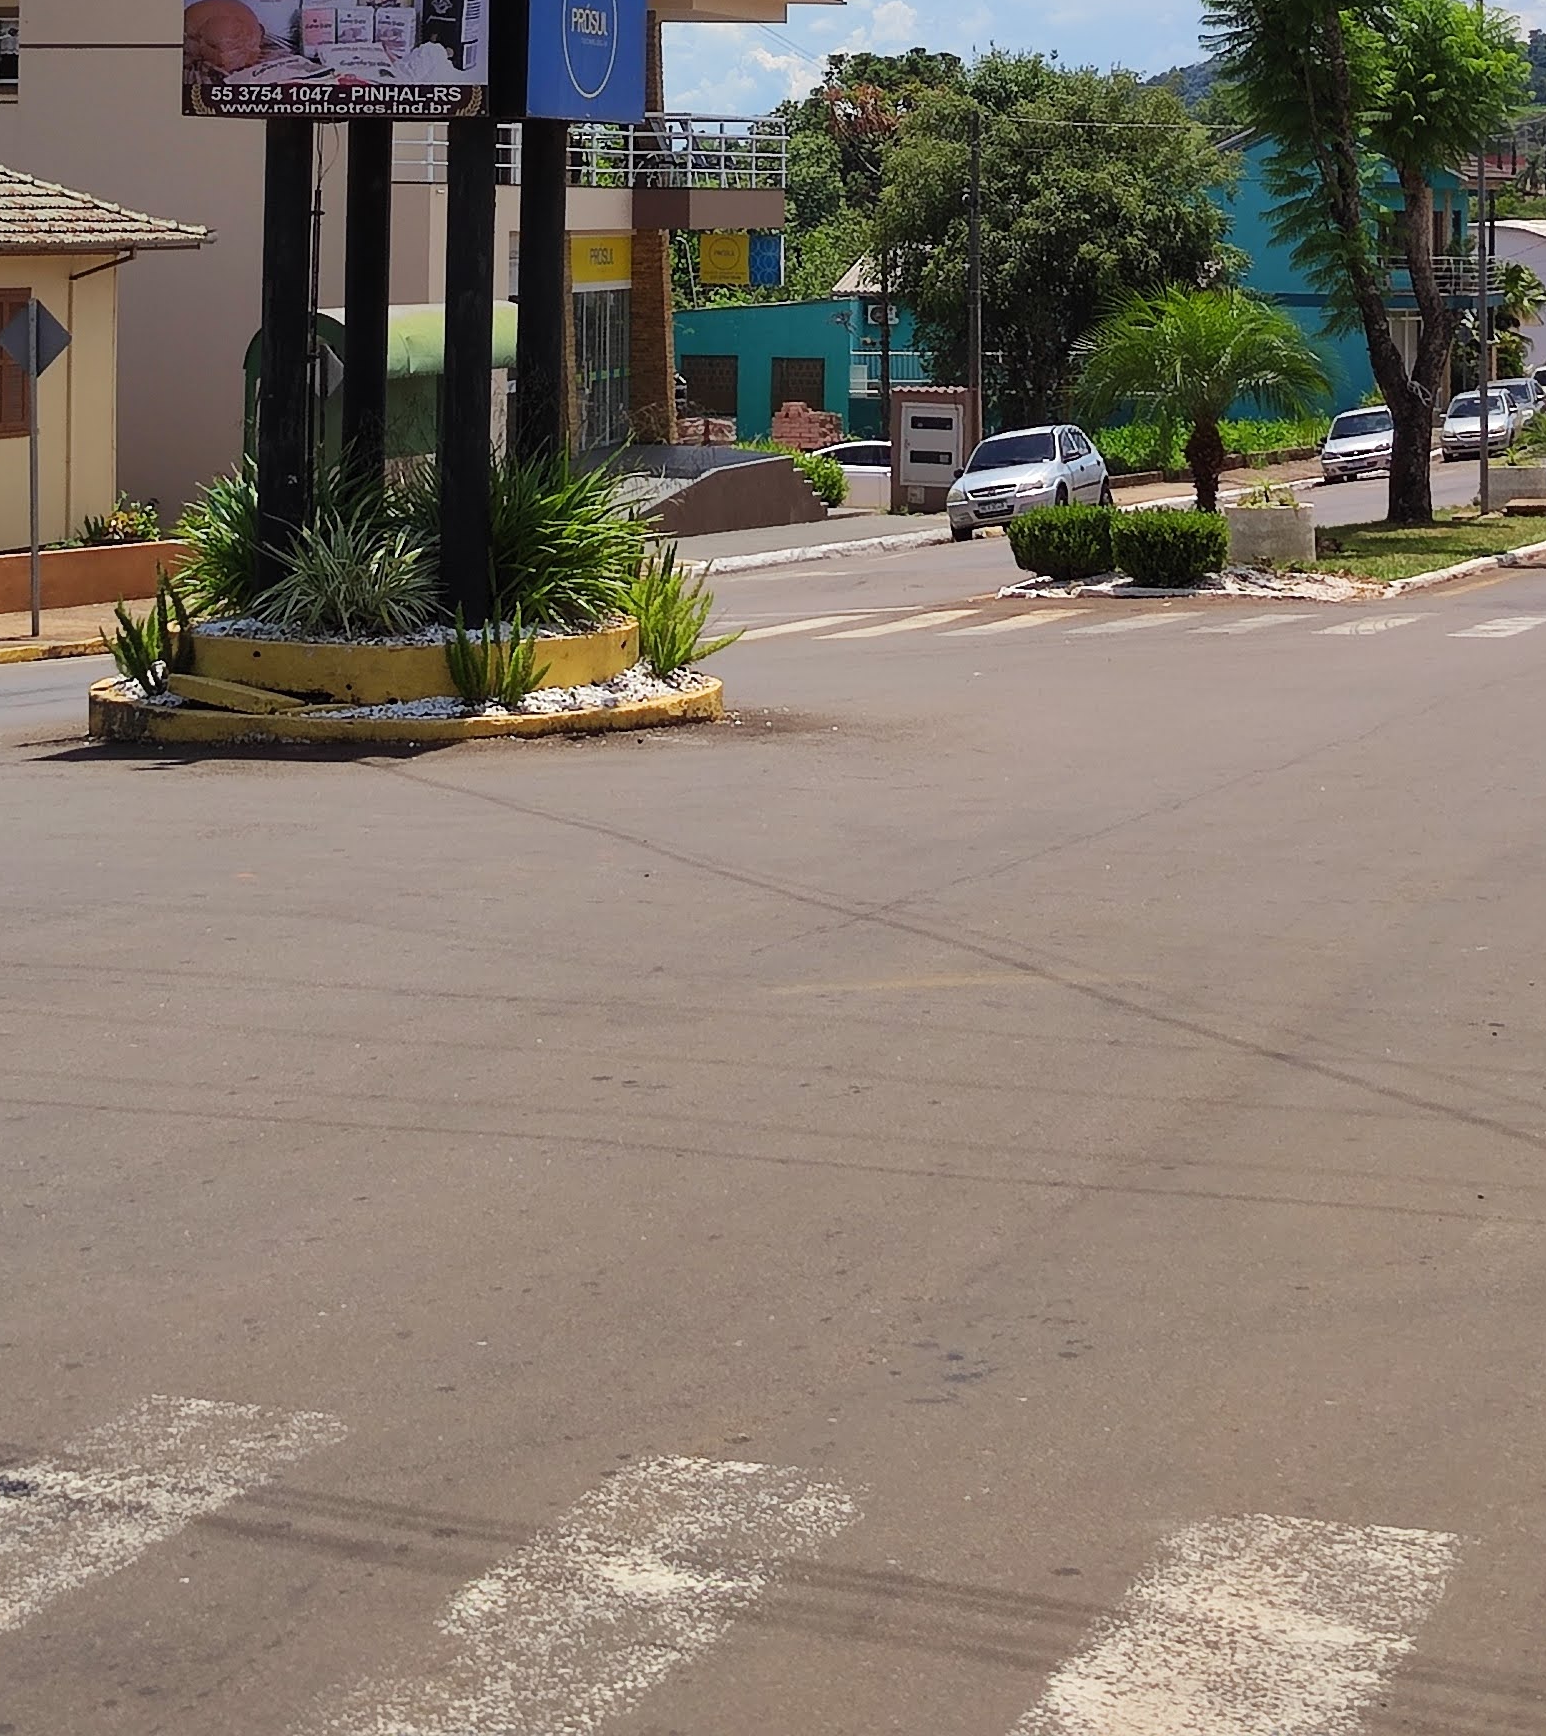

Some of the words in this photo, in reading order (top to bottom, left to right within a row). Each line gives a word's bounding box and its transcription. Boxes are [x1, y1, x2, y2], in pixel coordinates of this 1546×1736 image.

[211, 86, 233, 102] 55
[238, 86, 283, 102] 3754
[289, 86, 333, 102] 1047
[351, 85, 462, 102] PINHAL-RS
[221, 101, 452, 115] www.moinhotres.ind.br
